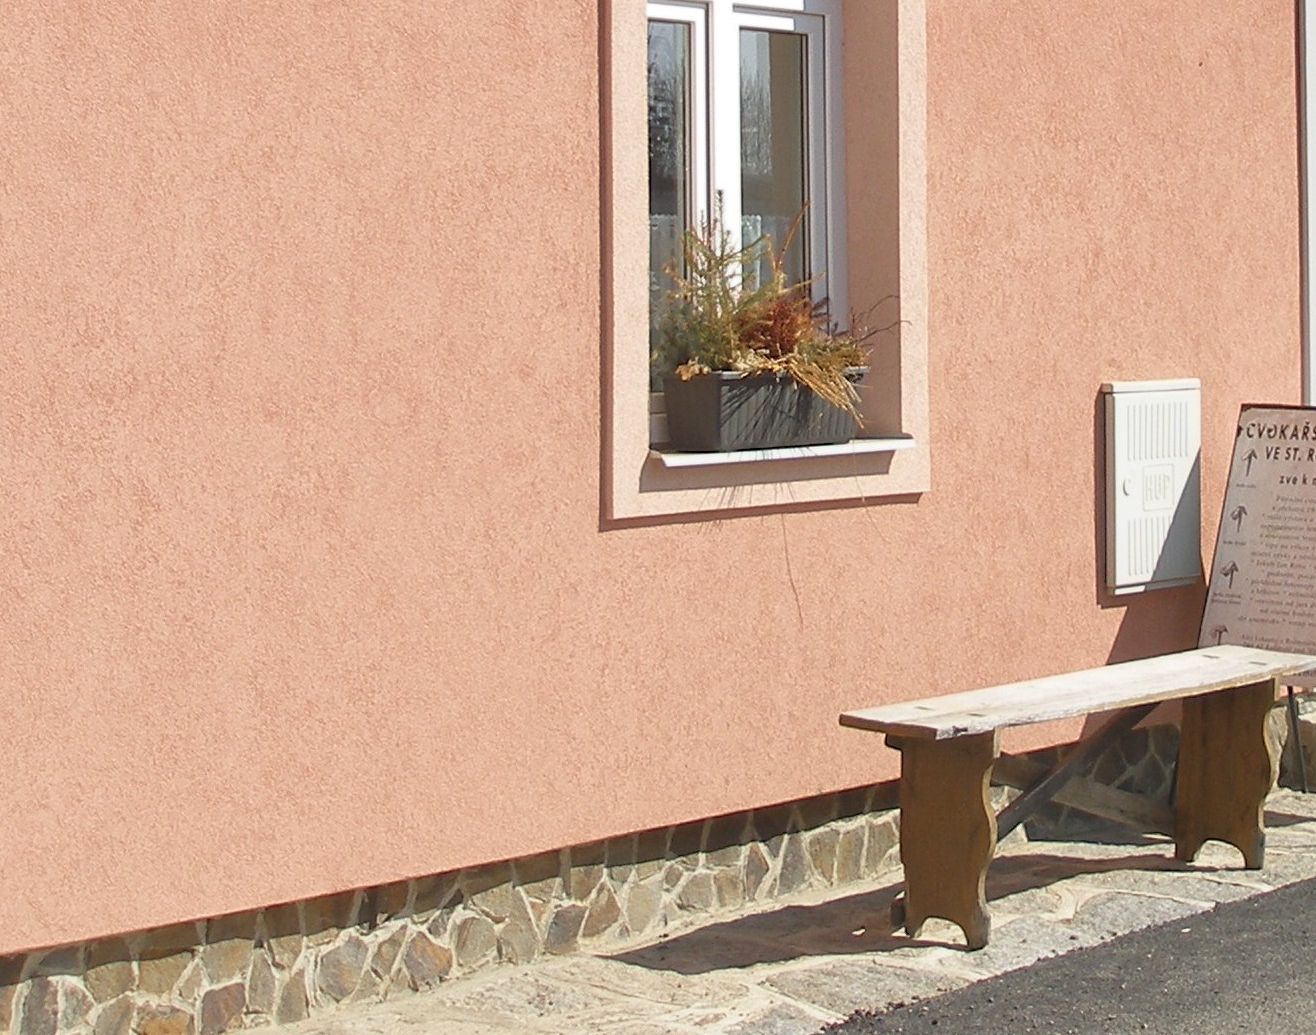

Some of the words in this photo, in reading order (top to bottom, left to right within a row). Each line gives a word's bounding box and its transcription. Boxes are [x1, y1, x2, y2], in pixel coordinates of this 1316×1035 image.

[1265, 446, 1280, 461] VE
[1284, 446, 1301, 462] ST.
[1145, 472, 1170, 501] HUP
[1279, 475, 1298, 485] zve
[1302, 473, 1308, 485] k
